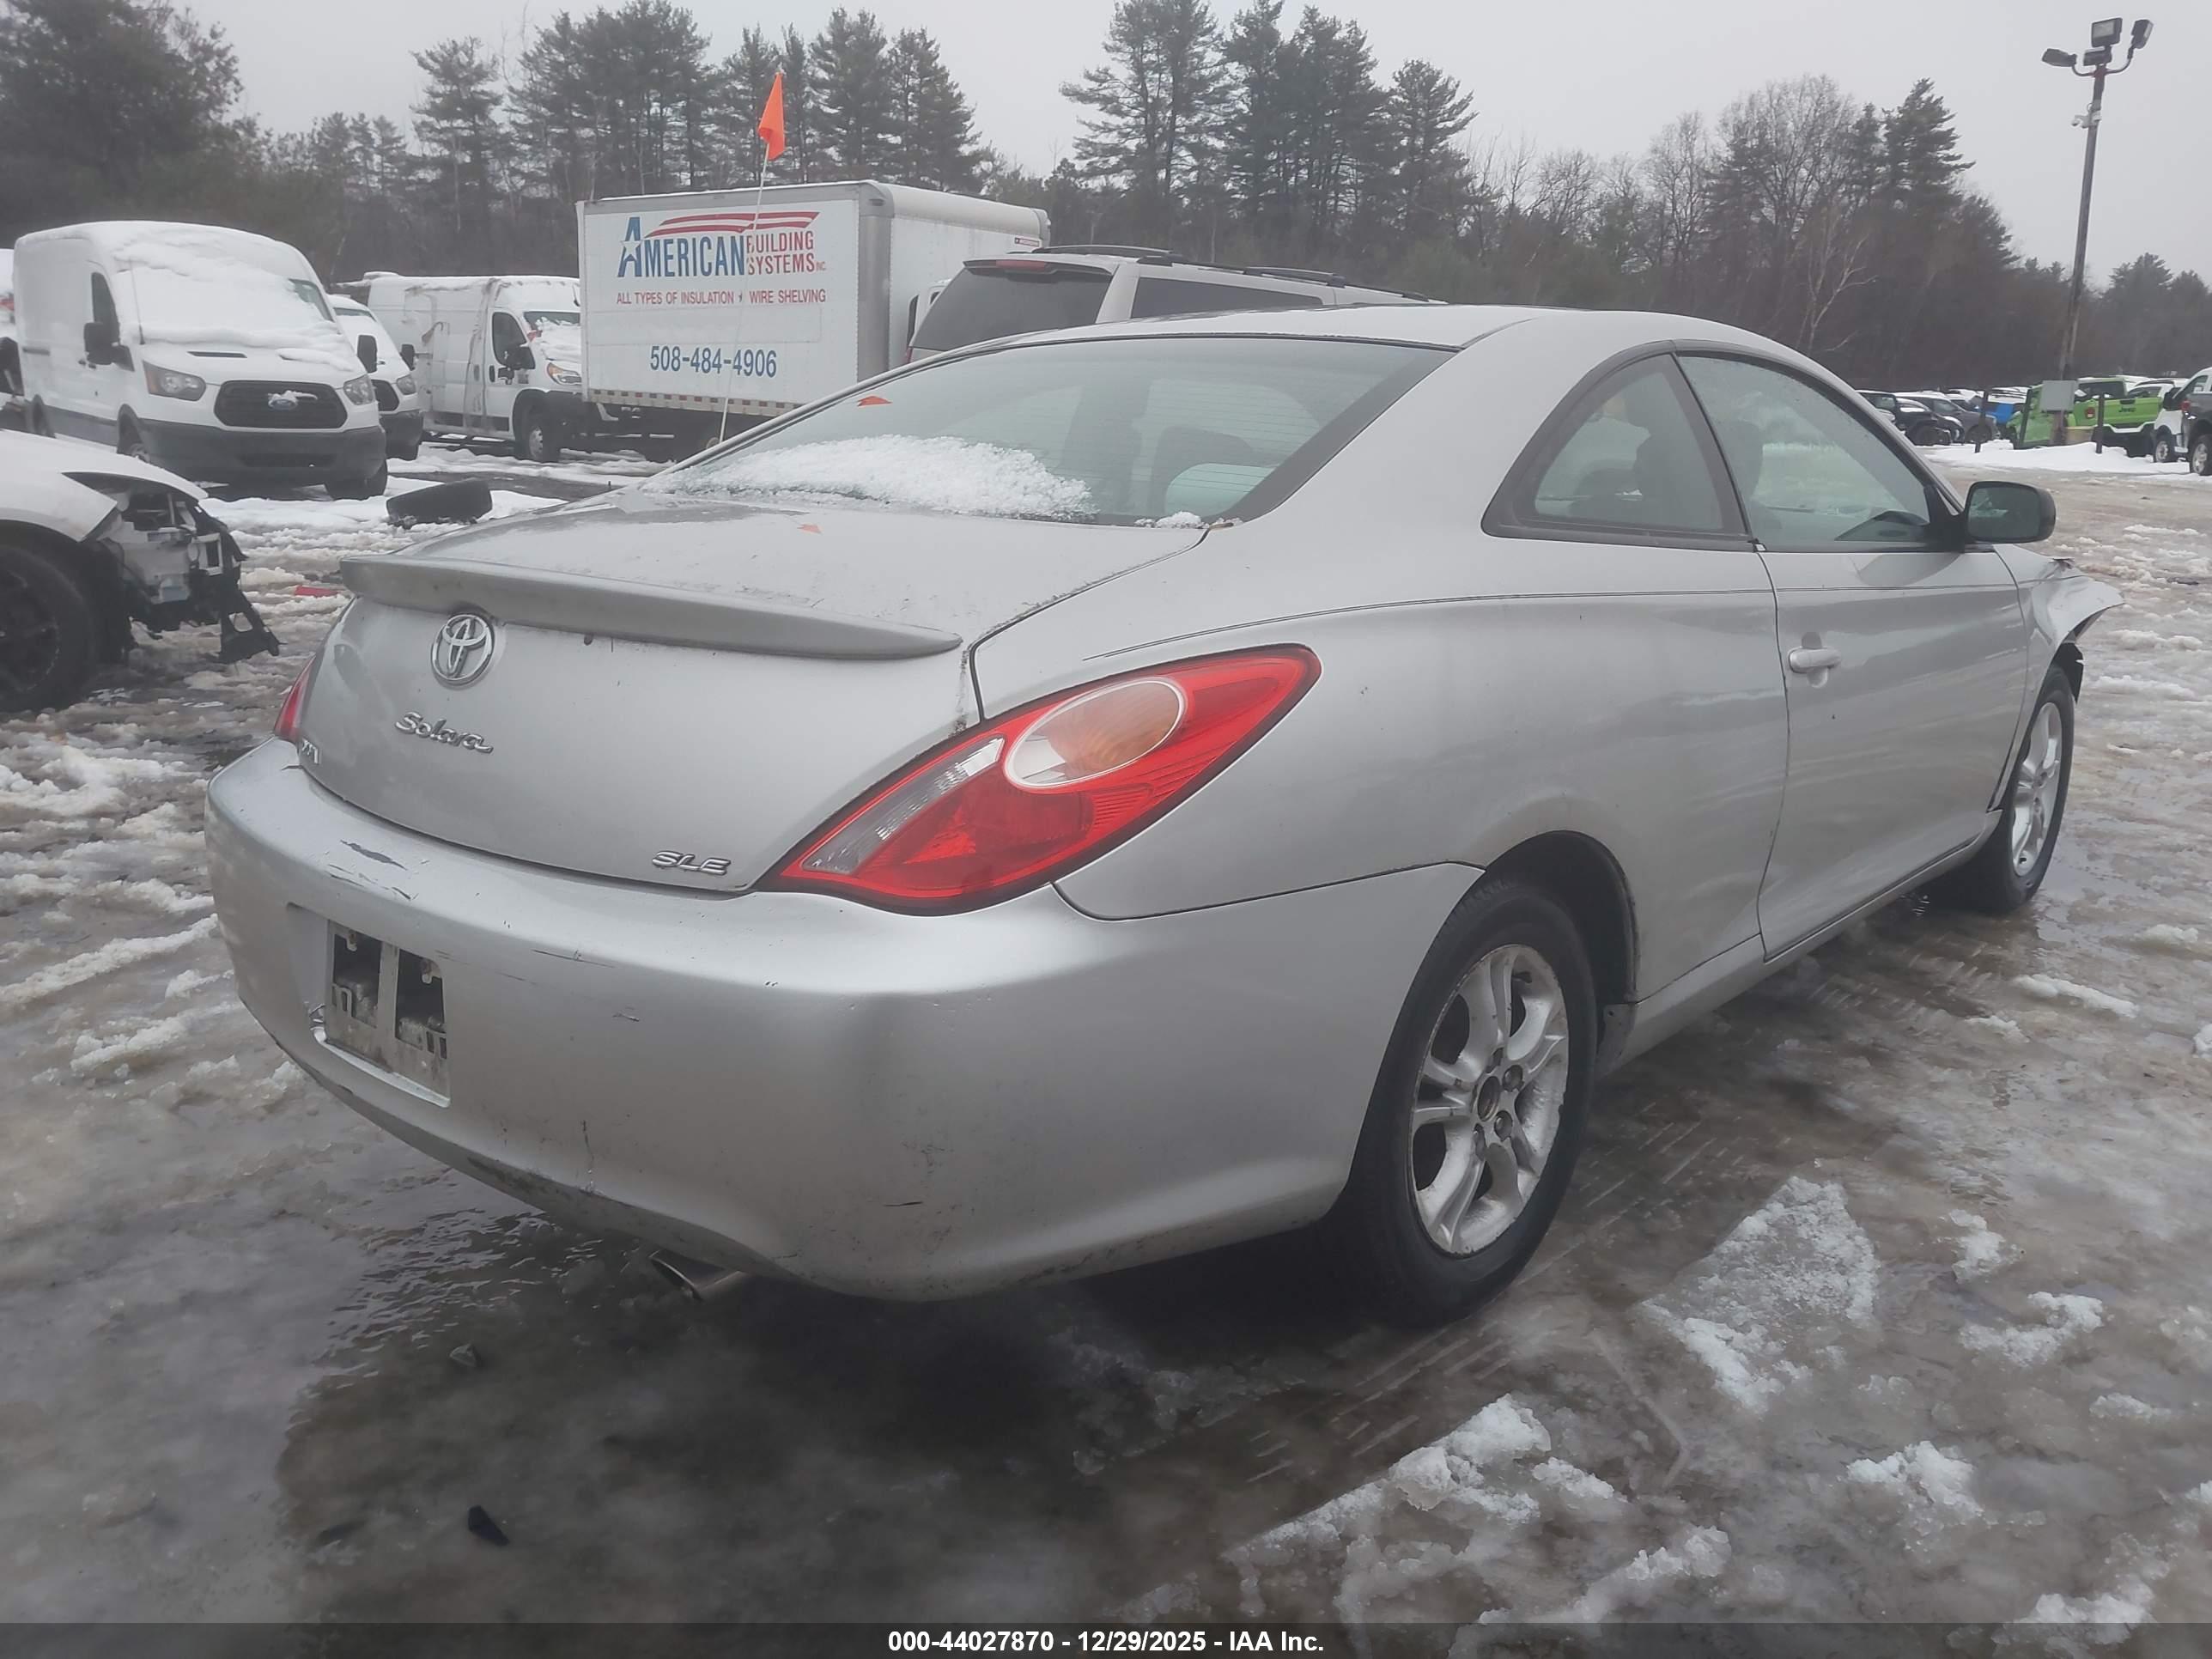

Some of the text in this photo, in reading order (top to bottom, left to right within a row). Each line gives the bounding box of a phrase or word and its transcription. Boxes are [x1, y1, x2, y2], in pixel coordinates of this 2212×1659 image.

[617, 216, 744, 277] AMERICAN
[746, 230, 814, 254] BUILDING
[747, 252, 815, 276] SYSTEMS
[617, 289, 826, 304] ALL TYPES OF INSULATION WIRE SHELVING
[650, 345, 777, 378] 508-484-4906
[395, 711, 494, 754] Solara
[653, 850, 731, 876] SLE
